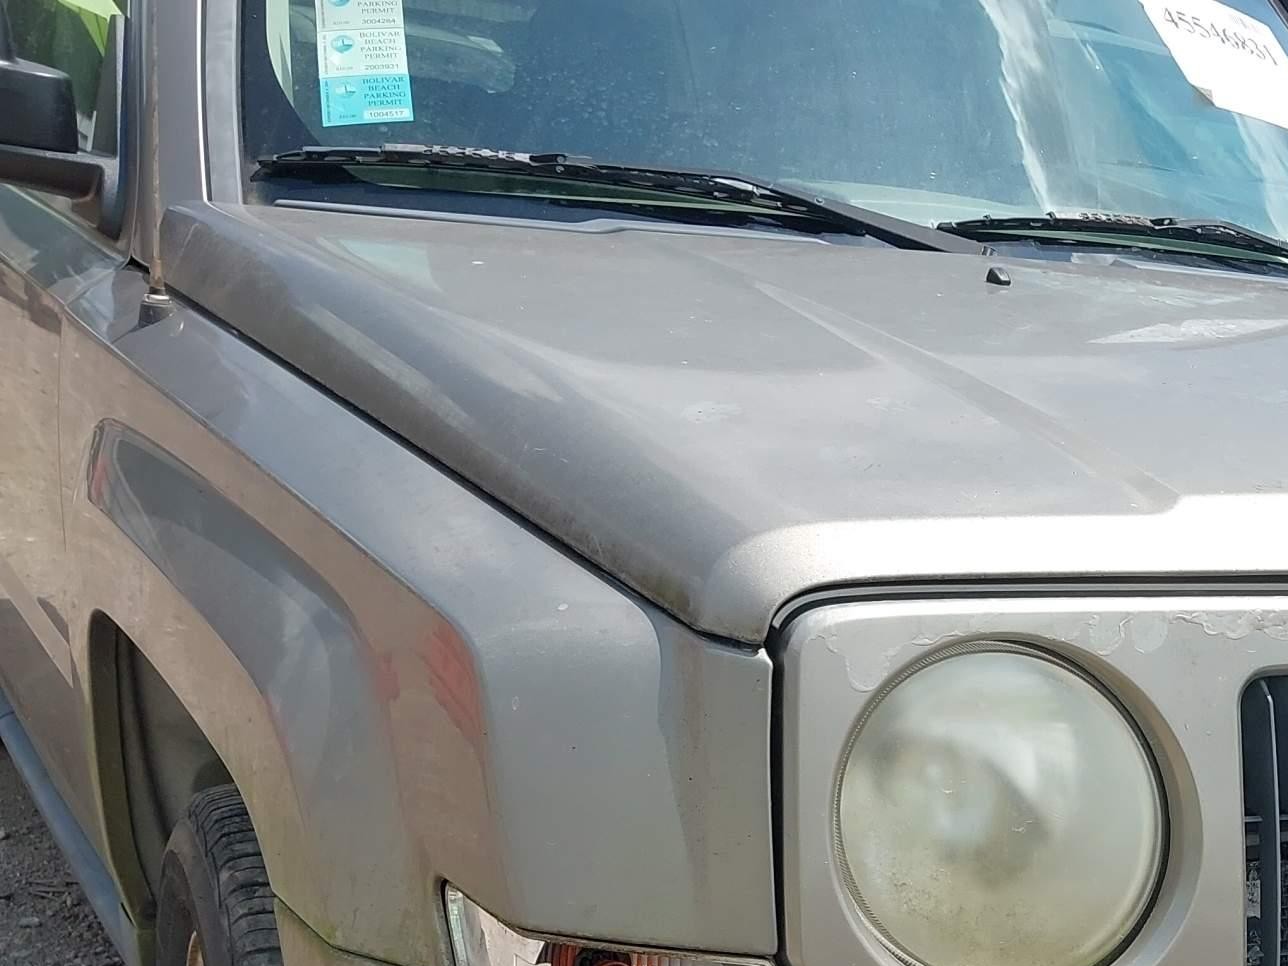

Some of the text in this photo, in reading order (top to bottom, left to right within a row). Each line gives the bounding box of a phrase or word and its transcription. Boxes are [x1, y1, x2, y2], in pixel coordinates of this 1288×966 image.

[1163, 8, 1278, 66] 45546831
[362, 77, 405, 85] BOLIVAR
[364, 91, 406, 99] PARKING
